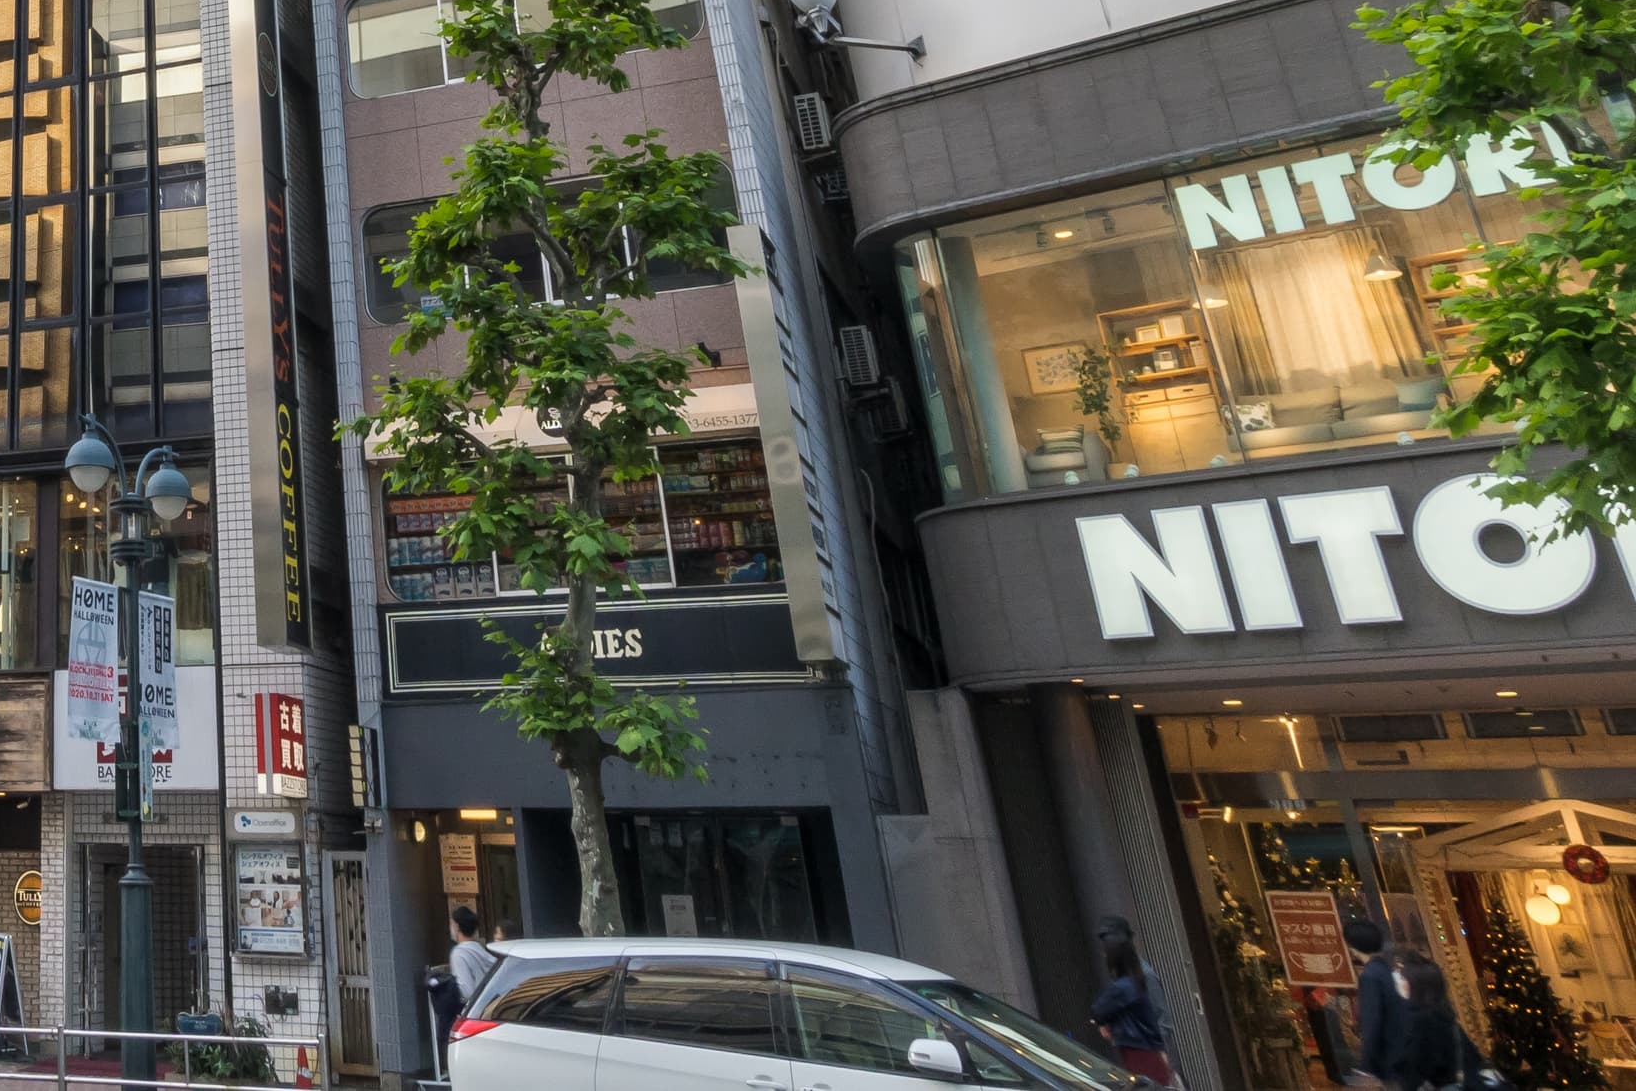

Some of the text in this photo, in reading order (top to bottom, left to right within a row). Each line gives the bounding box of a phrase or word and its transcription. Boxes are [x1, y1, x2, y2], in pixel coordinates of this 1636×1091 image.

[277, 402, 300, 624] COFFEE
[1075, 471, 1636, 640] NITO
[279, 700, 302, 735] 古着
[280, 738, 305, 771] 買取
